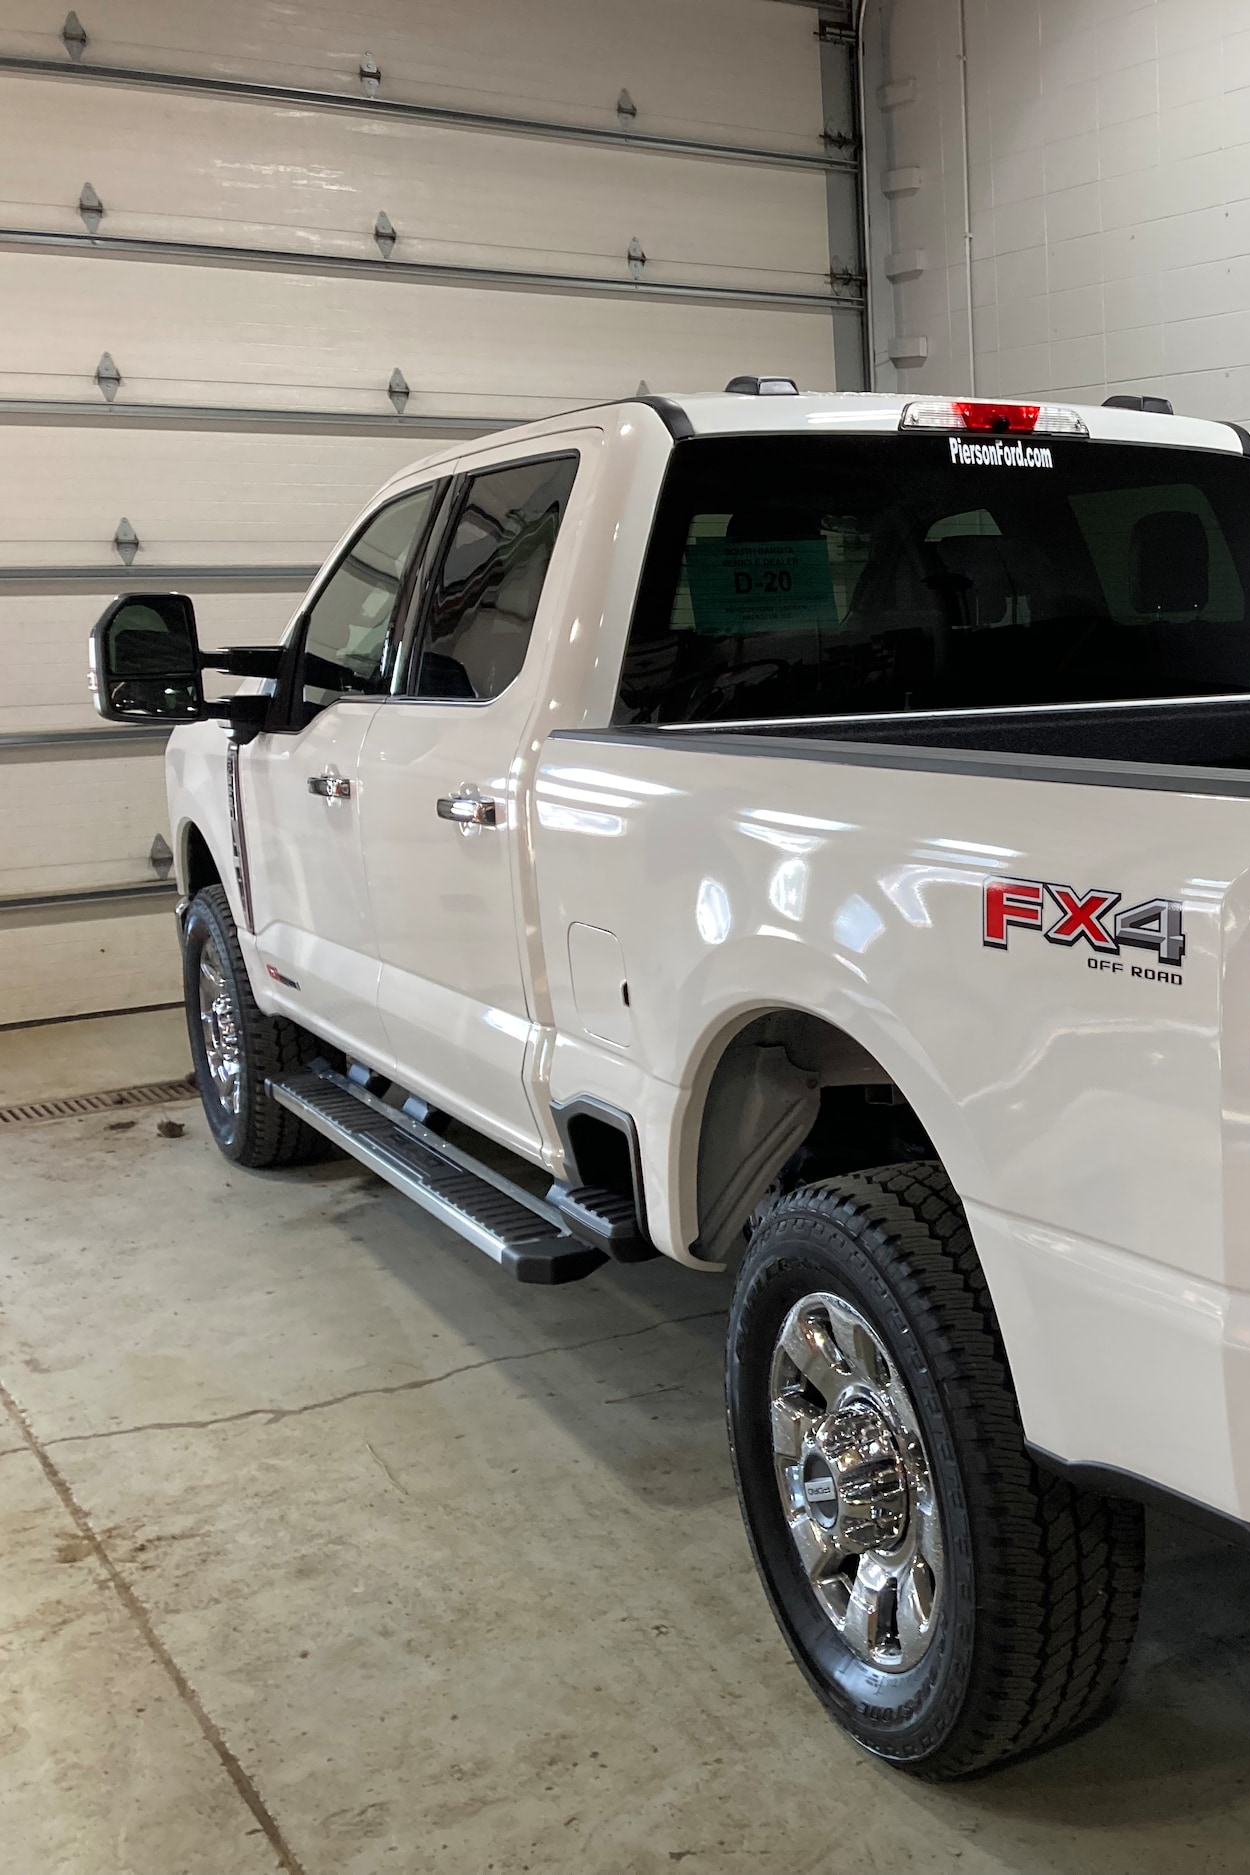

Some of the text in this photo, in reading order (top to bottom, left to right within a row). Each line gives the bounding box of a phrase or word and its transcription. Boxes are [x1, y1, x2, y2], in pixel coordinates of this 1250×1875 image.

[948, 437, 1053, 468] PiersonFord.com
[734, 570, 792, 594] D-20
[982, 874, 1186, 966] FX4
[1087, 957, 1182, 985] OFF ROAD
